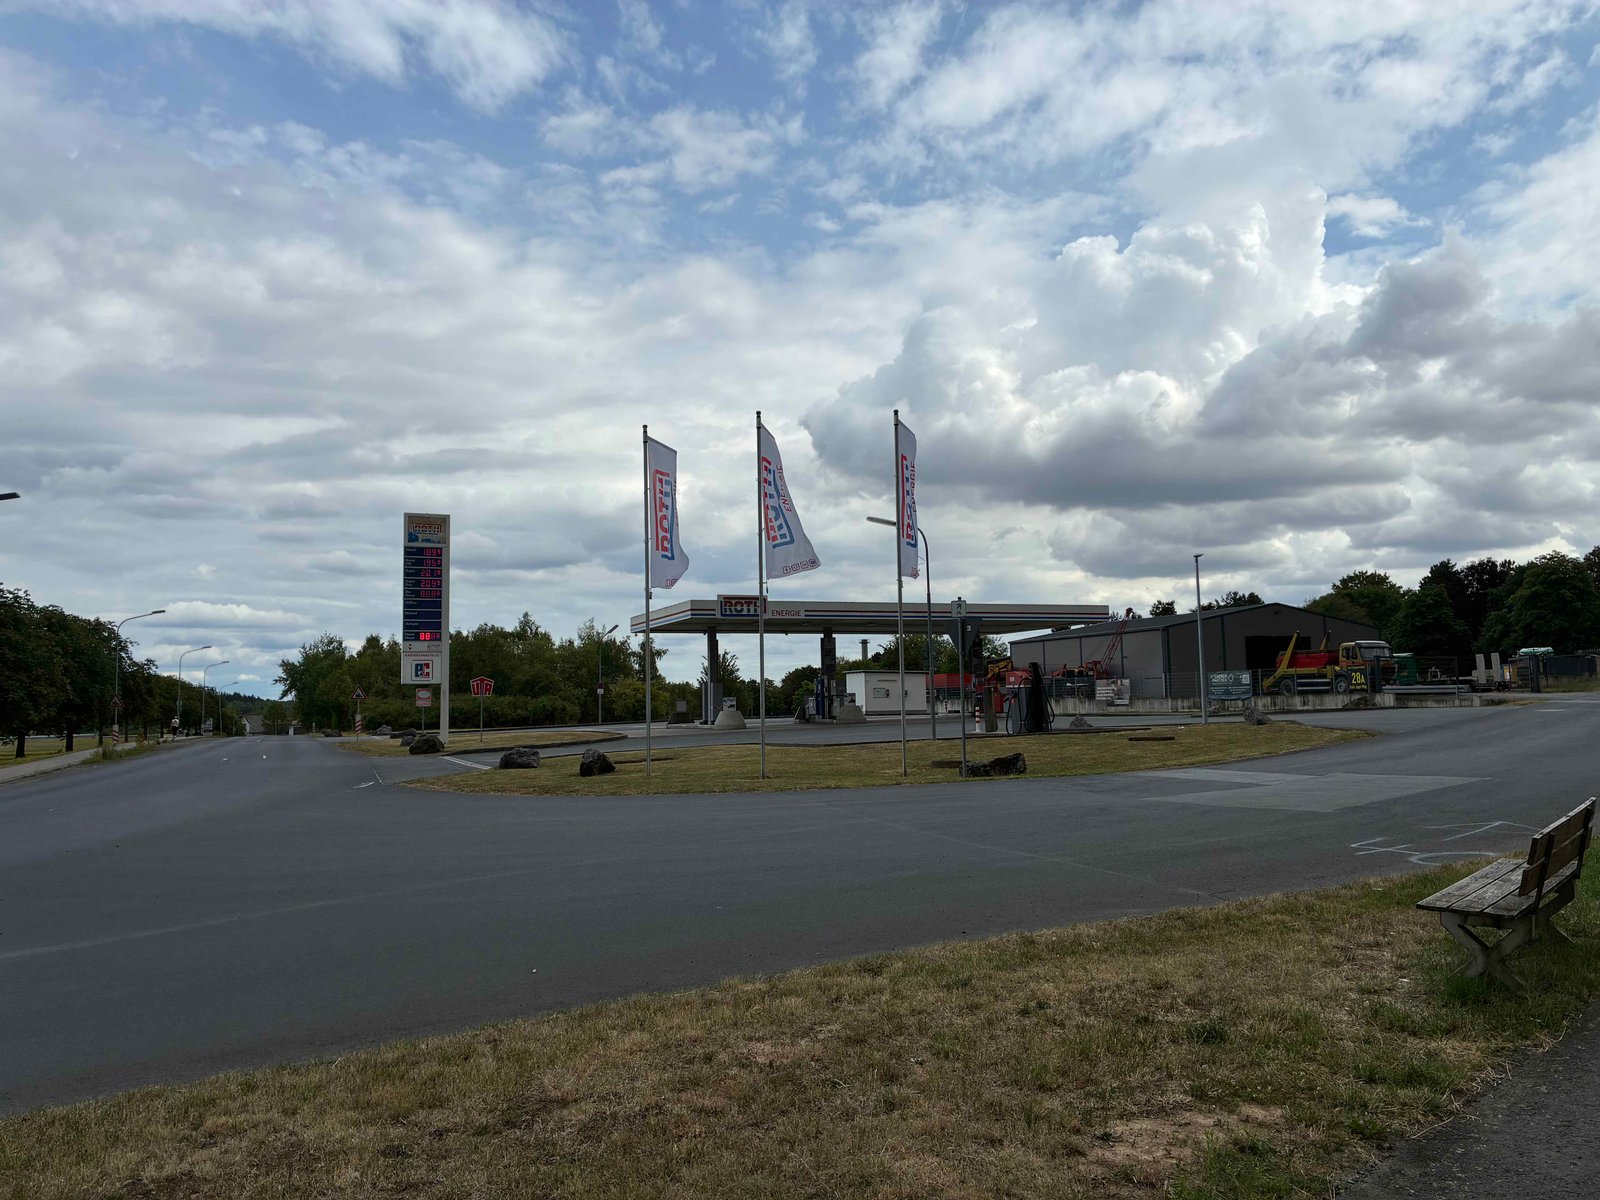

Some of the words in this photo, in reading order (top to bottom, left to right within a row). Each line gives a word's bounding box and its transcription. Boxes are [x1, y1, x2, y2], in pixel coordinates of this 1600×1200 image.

[414, 524, 440, 533] ROTH
[771, 609, 802, 617] ENERGIE
[1351, 672, 1366, 684] 28A
